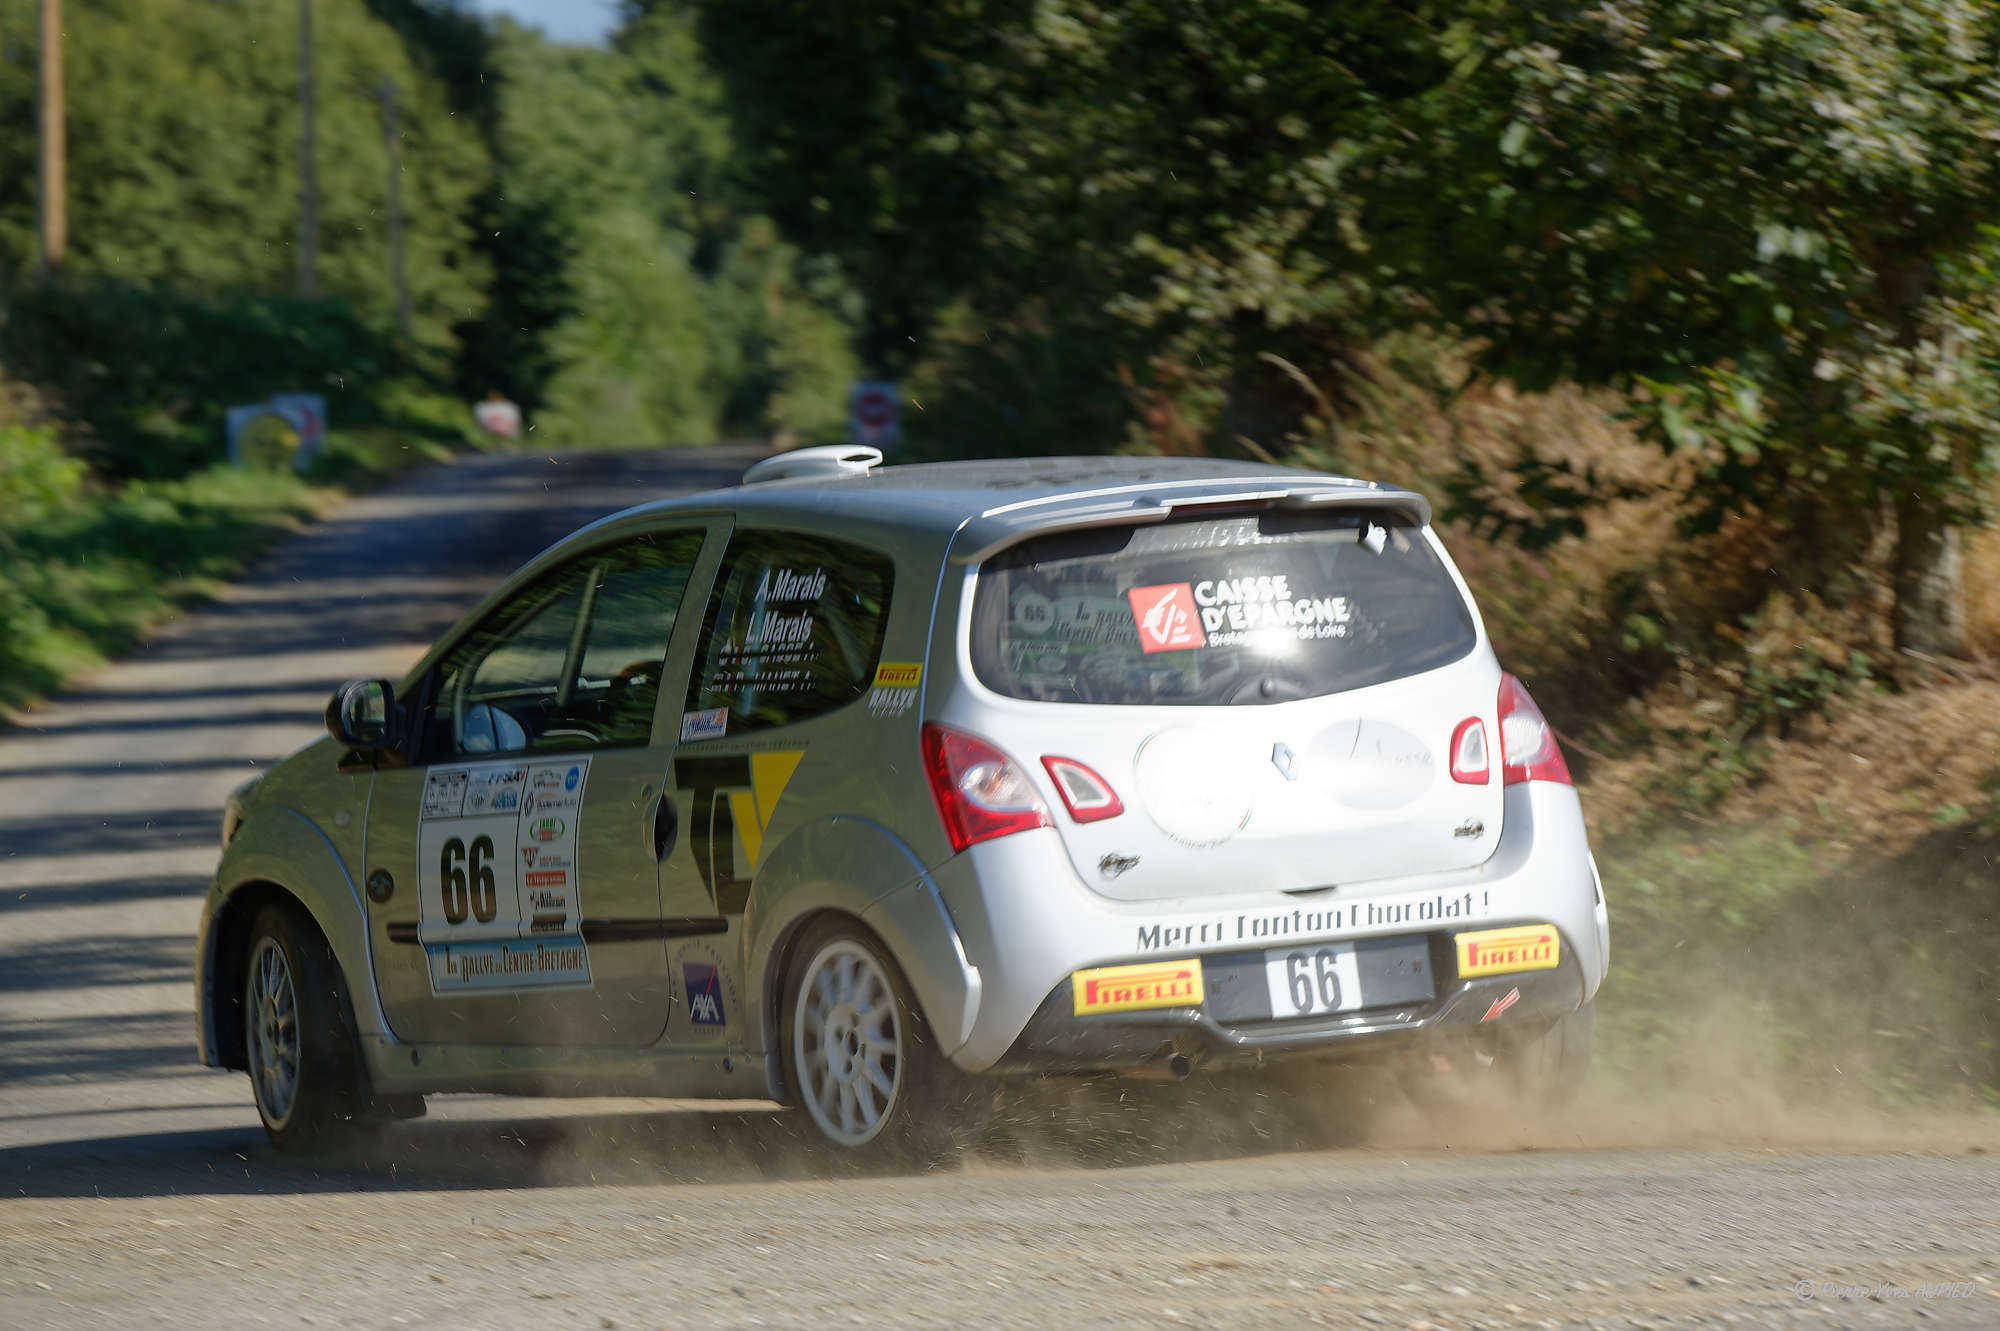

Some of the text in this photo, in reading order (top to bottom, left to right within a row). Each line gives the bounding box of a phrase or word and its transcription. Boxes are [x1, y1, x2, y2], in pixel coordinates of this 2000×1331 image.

[754, 568, 826, 602] A.Marais
[1194, 575, 1292, 607] CAISSE
[1201, 597, 1350, 632] D'EPARGNE
[878, 666, 919, 681] PIRELLI
[441, 835, 497, 925] 66
[1468, 935, 1551, 968] PIRELLI
[1085, 970, 1193, 1006] PIRELLI
[1286, 948, 1342, 1015] 66
[690, 993, 720, 1022] AXA
